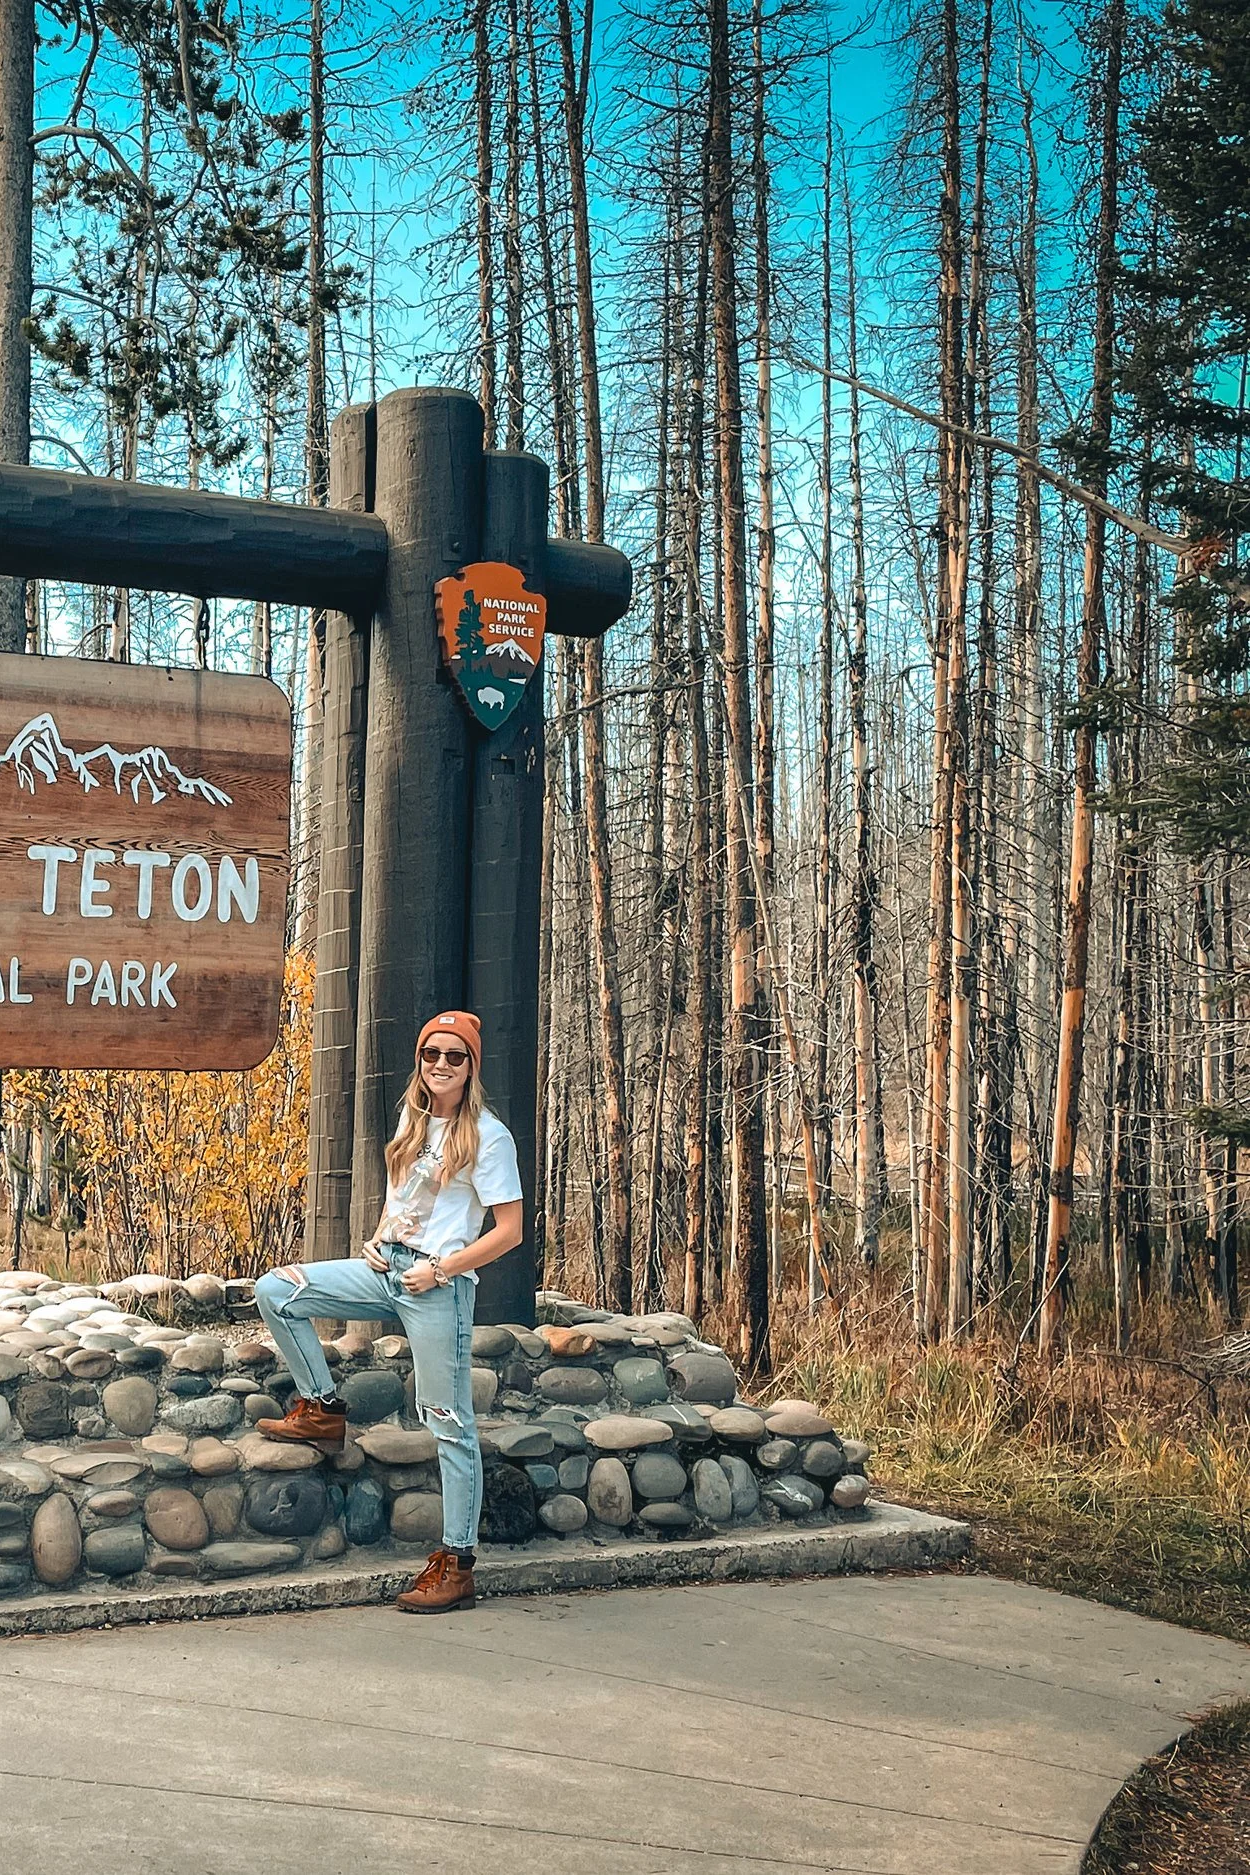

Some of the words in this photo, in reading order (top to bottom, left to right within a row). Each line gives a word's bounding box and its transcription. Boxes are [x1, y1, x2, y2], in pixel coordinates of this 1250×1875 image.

[483, 598, 540, 614] NATIONAL
[497, 612, 526, 624] PARK
[488, 624, 535, 638] SERVICE
[27, 844, 260, 924] TETON
[66, 957, 178, 1009] PARK
